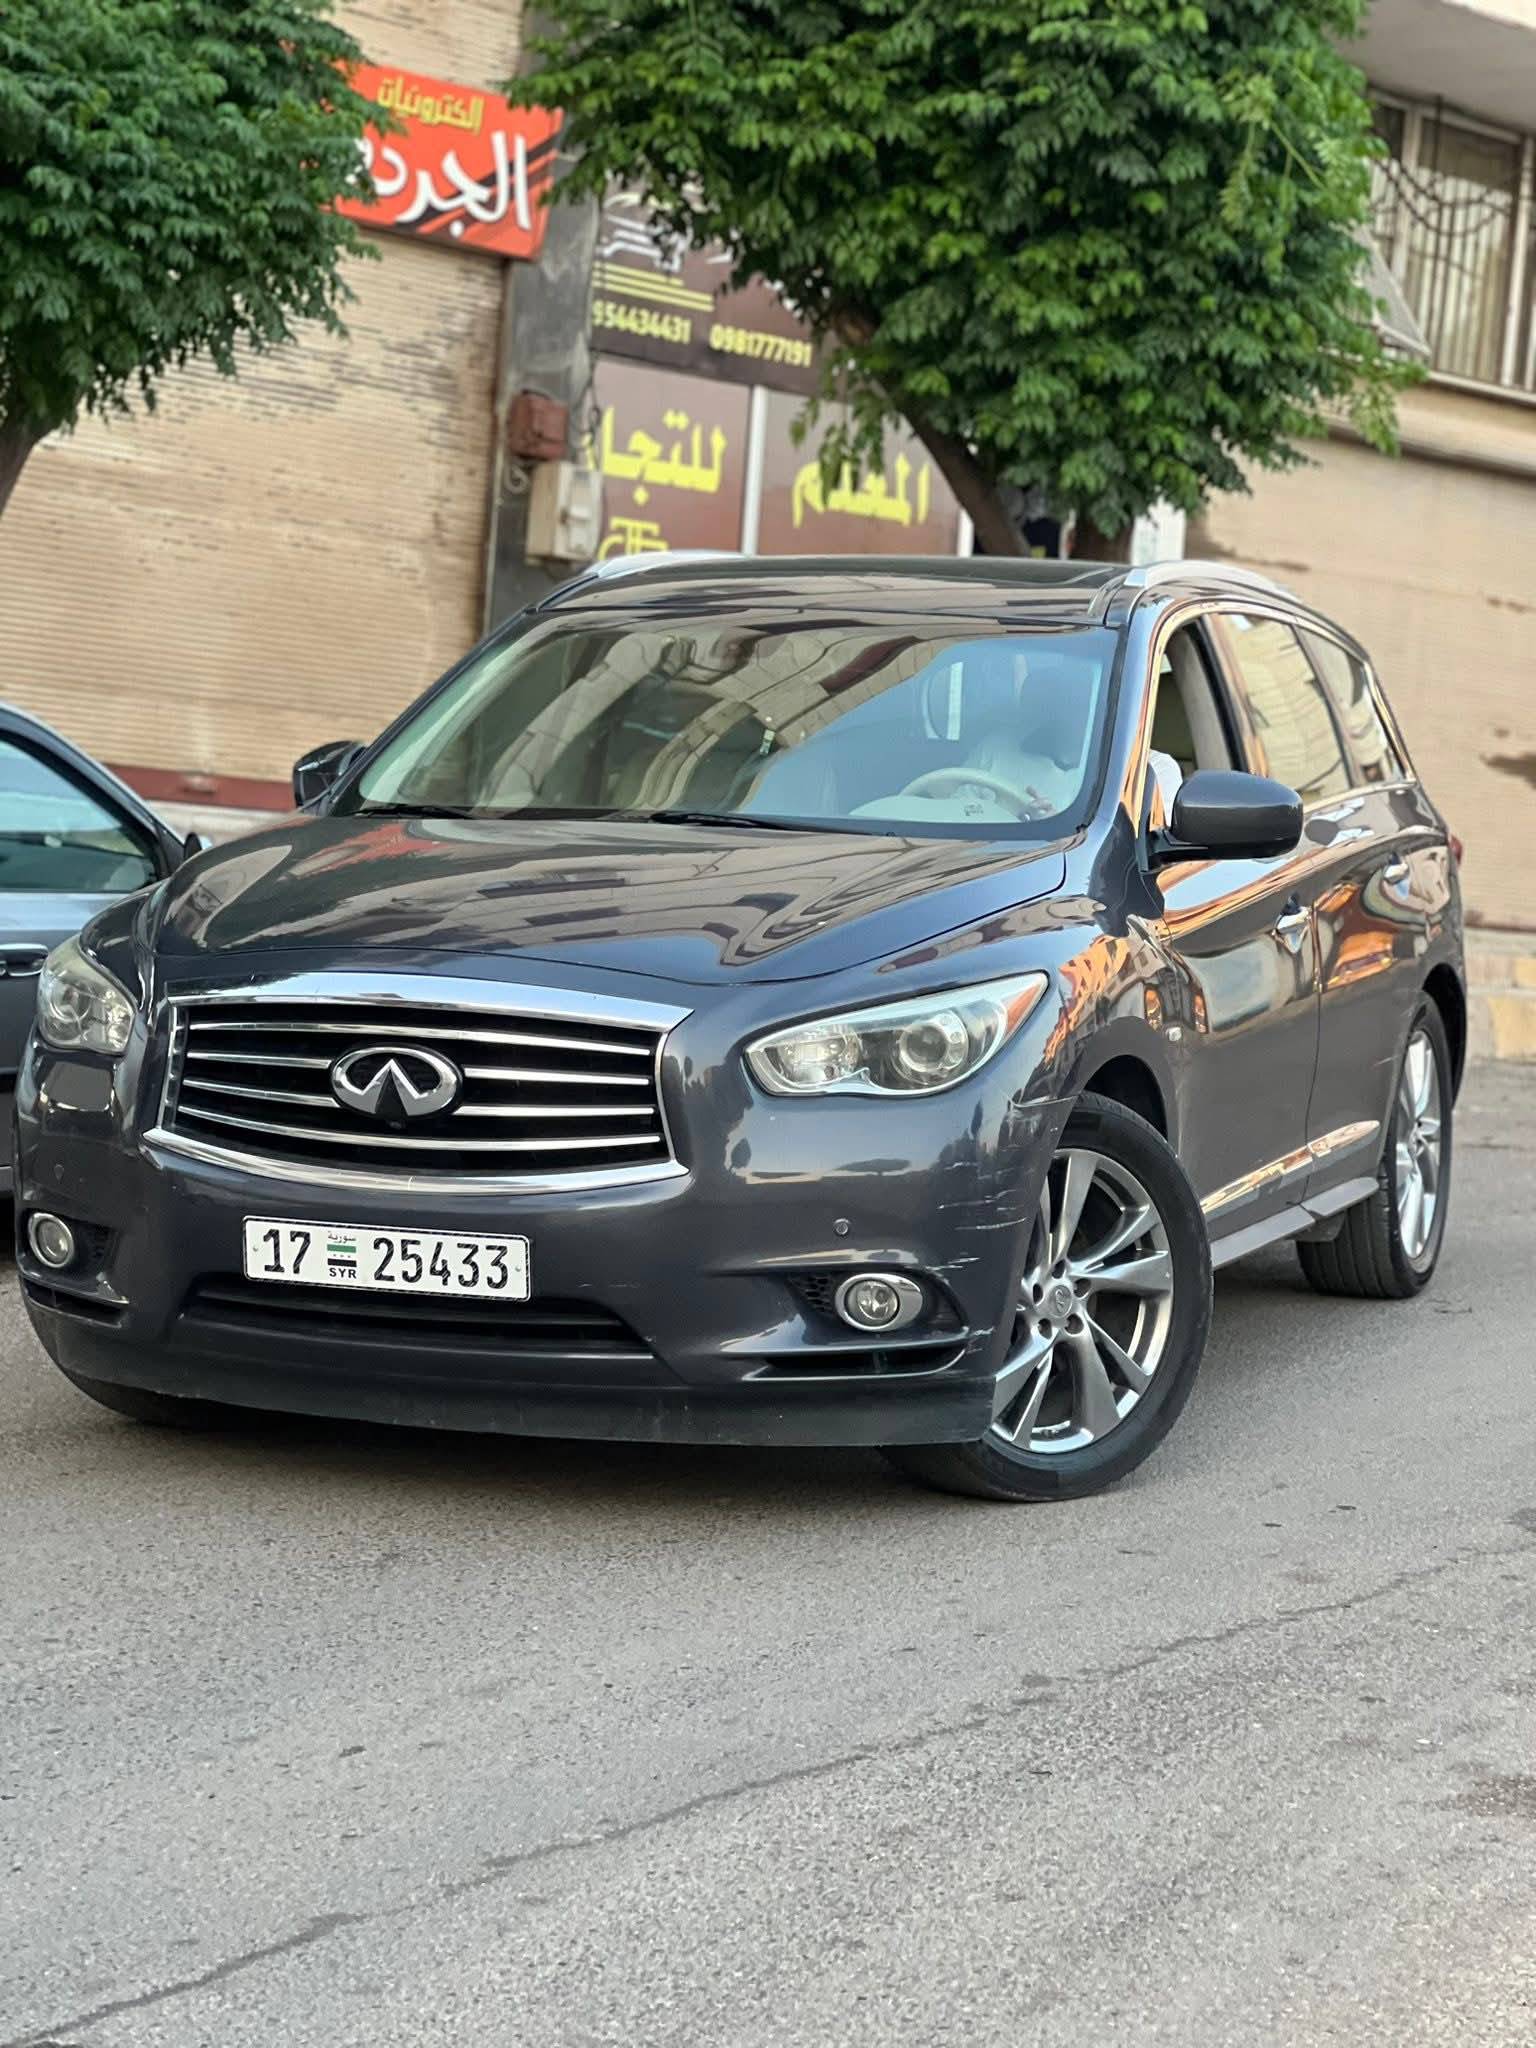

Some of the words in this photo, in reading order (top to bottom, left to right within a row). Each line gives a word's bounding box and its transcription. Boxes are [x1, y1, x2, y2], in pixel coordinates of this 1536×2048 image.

[327, 1230, 357, 1244] سورية
[263, 1228, 311, 1275] 17
[373, 1237, 509, 1289] 25433
[329, 1267, 357, 1280] SYR
